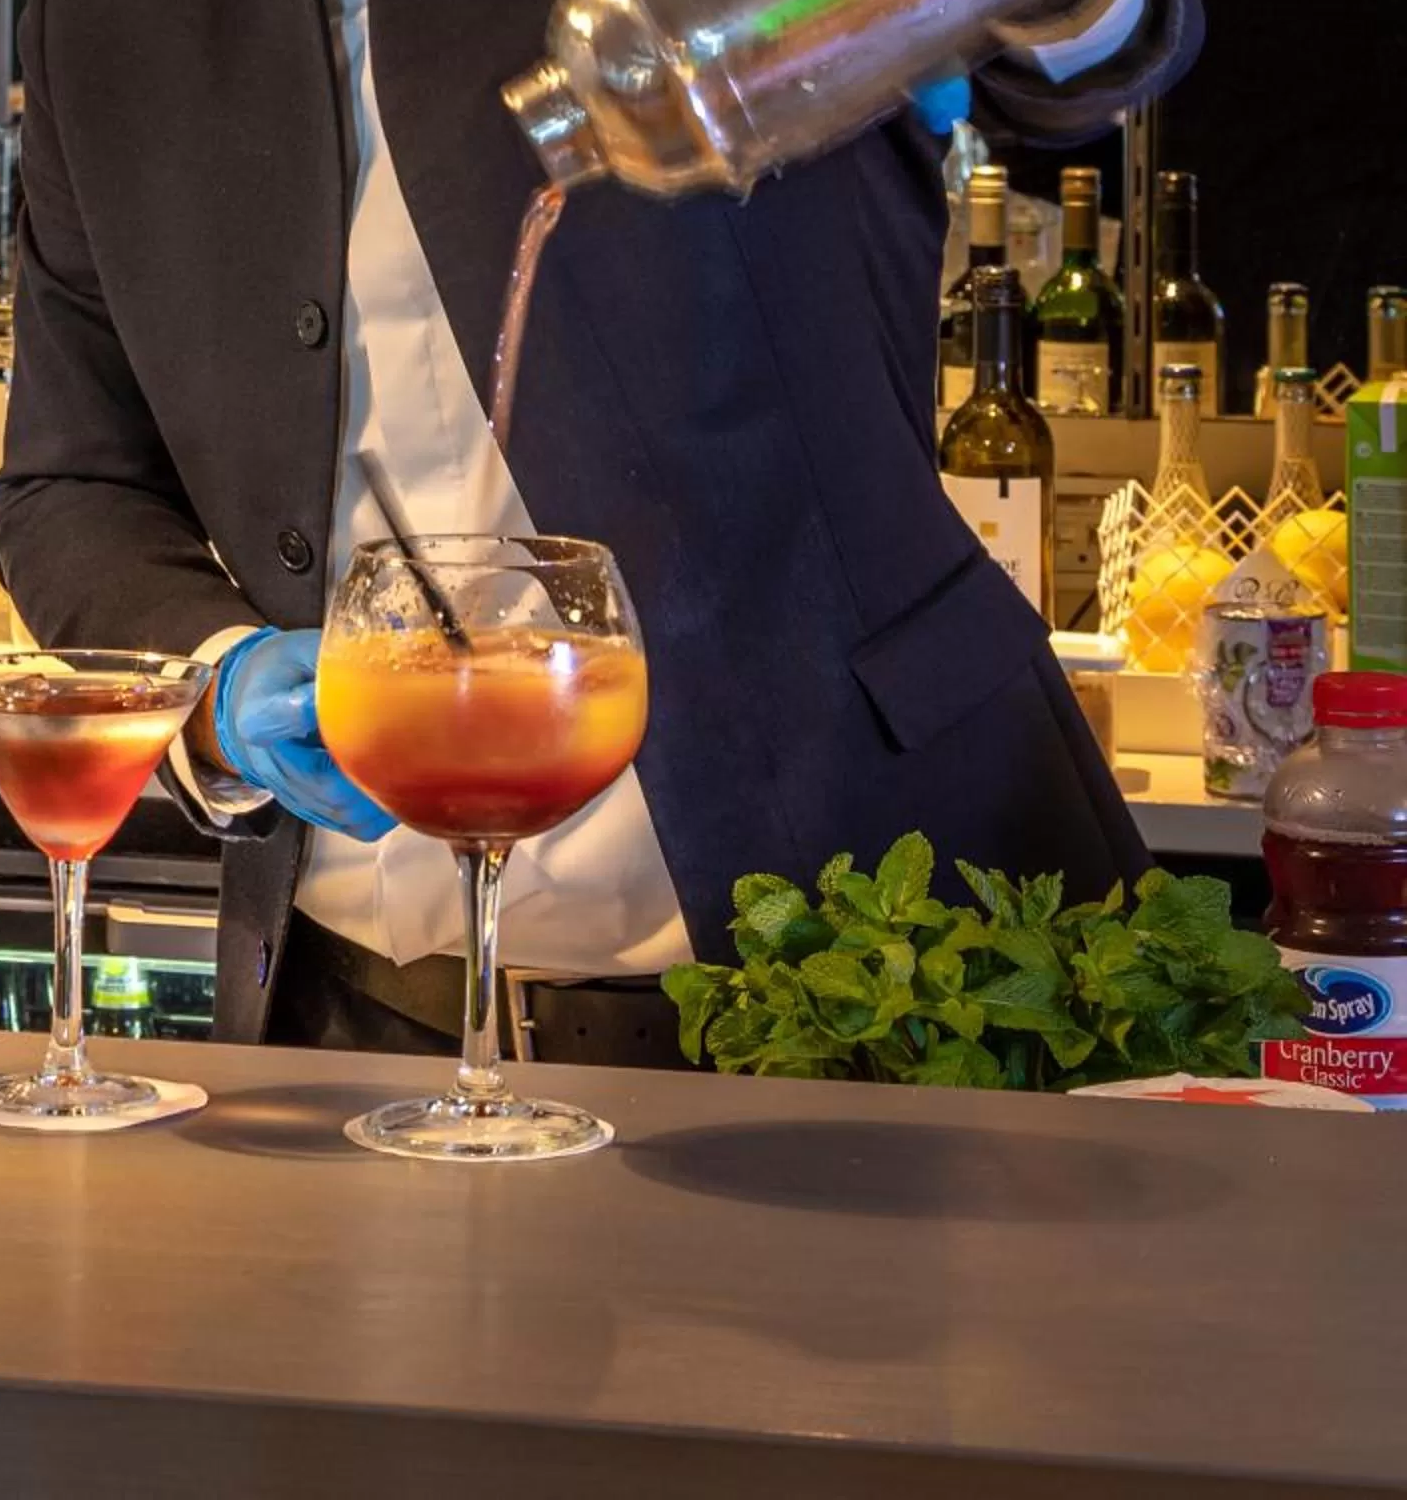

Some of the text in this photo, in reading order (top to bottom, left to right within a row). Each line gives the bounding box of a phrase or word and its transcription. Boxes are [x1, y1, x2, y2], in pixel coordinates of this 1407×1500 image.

[1329, 992, 1375, 1026] Spray
[1280, 1040, 1393, 1079] Cranberry
[1300, 1064, 1363, 1089] Classic
